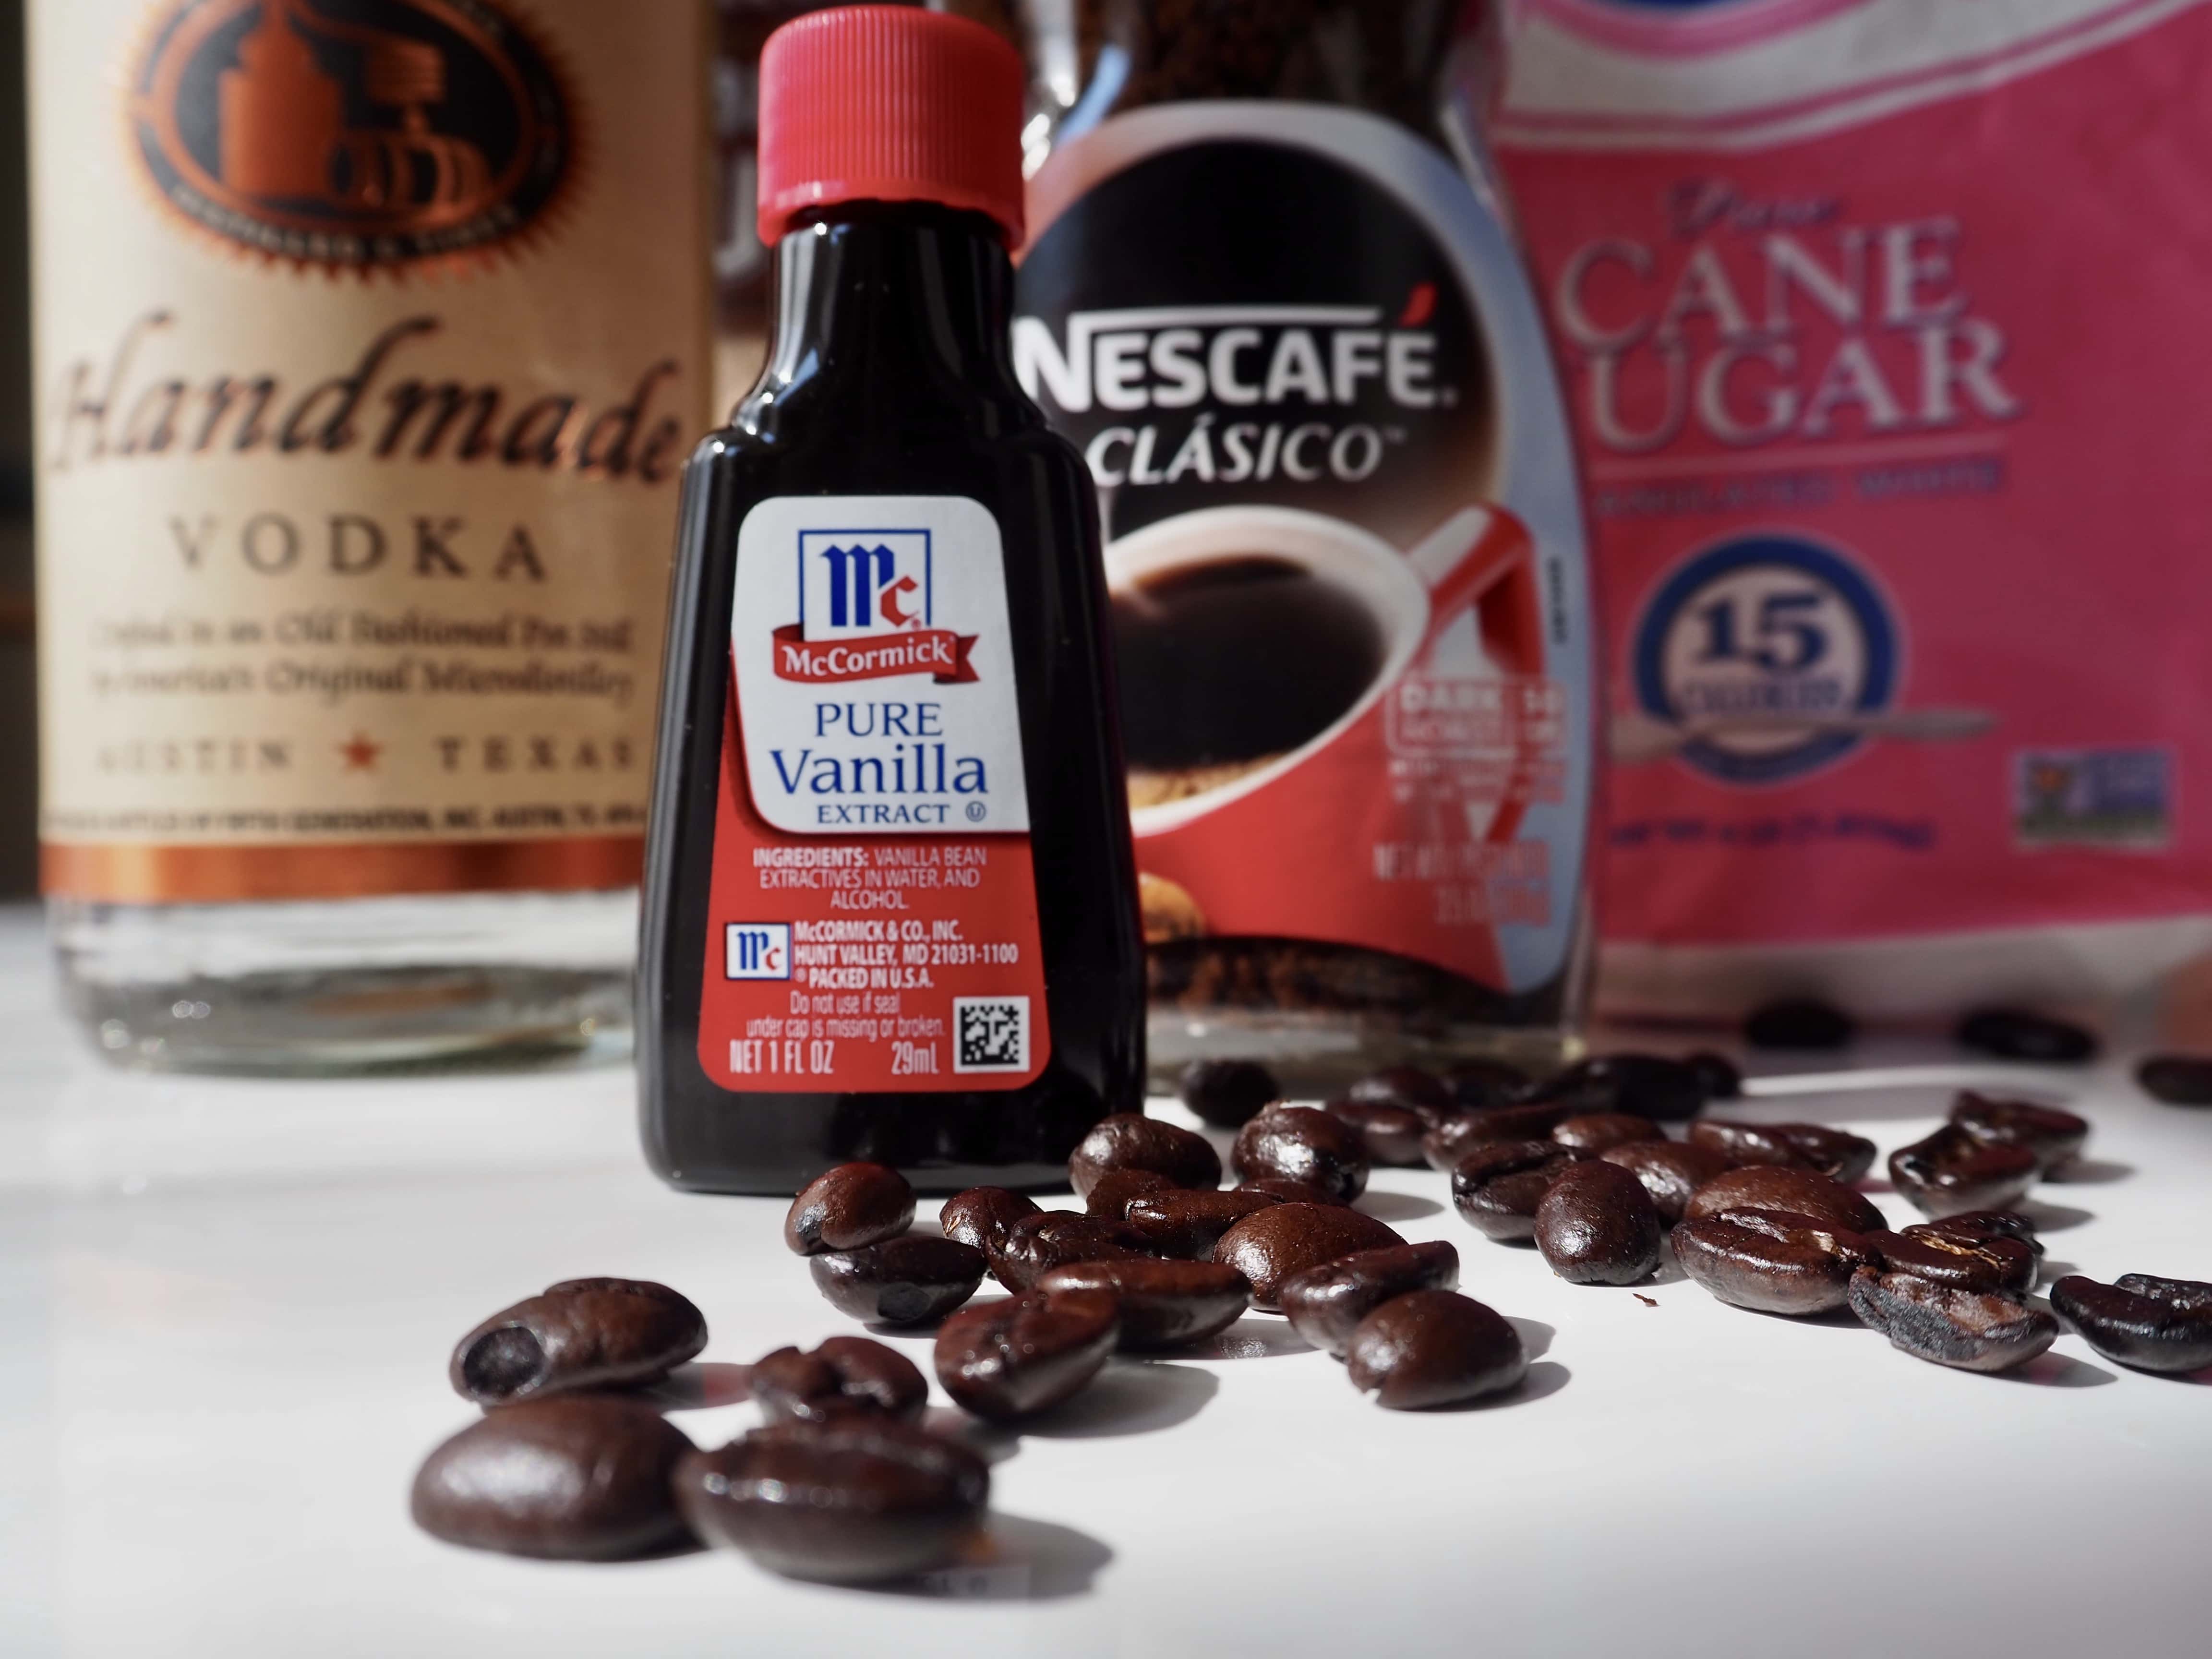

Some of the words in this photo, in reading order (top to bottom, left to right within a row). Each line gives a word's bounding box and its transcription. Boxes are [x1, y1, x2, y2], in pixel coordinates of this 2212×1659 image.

[1555, 214, 1967, 353] CANE
[1012, 282, 1436, 413] NESCAFÉ
[48, 311, 681, 486] Handmade
[1586, 317, 2024, 455] UGAR
[1083, 411, 1384, 487] CLÁSICO
[168, 511, 549, 583] VODKA
[1691, 591, 1830, 674] 15
[781, 636, 953, 676] McCormick
[815, 703, 944, 737] PURE
[435, 737, 635, 773] TEXAS
[769, 743, 989, 794] Vanilla
[817, 804, 950, 824] EXTRACT
[753, 847, 869, 867] INGREDIENTS:
[874, 847, 941, 866] VANILLA
[944, 847, 987, 866] BEAN
[760, 868, 862, 889] EXTRACTIVES
[865, 869, 883, 888] IN
[884, 869, 941, 890] WATER,
[943, 868, 980, 888] AND
[830, 890, 909, 910] ALCOHOL.
[794, 920, 884, 943] McCORMICK
[886, 921, 899, 942] &
[932, 920, 963, 941] INC.
[794, 944, 836, 965] HUNT
[839, 943, 898, 967] VALLEY,
[902, 944, 928, 964] MD
[930, 943, 1018, 964] 21031-1100
[808, 967, 868, 989] PACKED
[870, 967, 888, 989] IN
[890, 967, 934, 989] U.S.A.
[790, 991, 810, 1015] Do
[812, 993, 834, 1014] not
[836, 995, 859, 1014] use
[862, 991, 872, 1013] if
[874, 992, 900, 1014] seal
[746, 1017, 783, 1038] under
[784, 1019, 810, 1043] cap
[812, 1018, 824, 1038] is
[826, 1018, 878, 1042] missing
[879, 1020, 895, 1038] or
[897, 1017, 946, 1038] broken.
[729, 1040, 764, 1074] NET
[769, 1040, 780, 1074] 1
[784, 1040, 805, 1074] FL
[810, 1040, 835, 1074] OZ
[891, 1041, 940, 1075] 29mL
